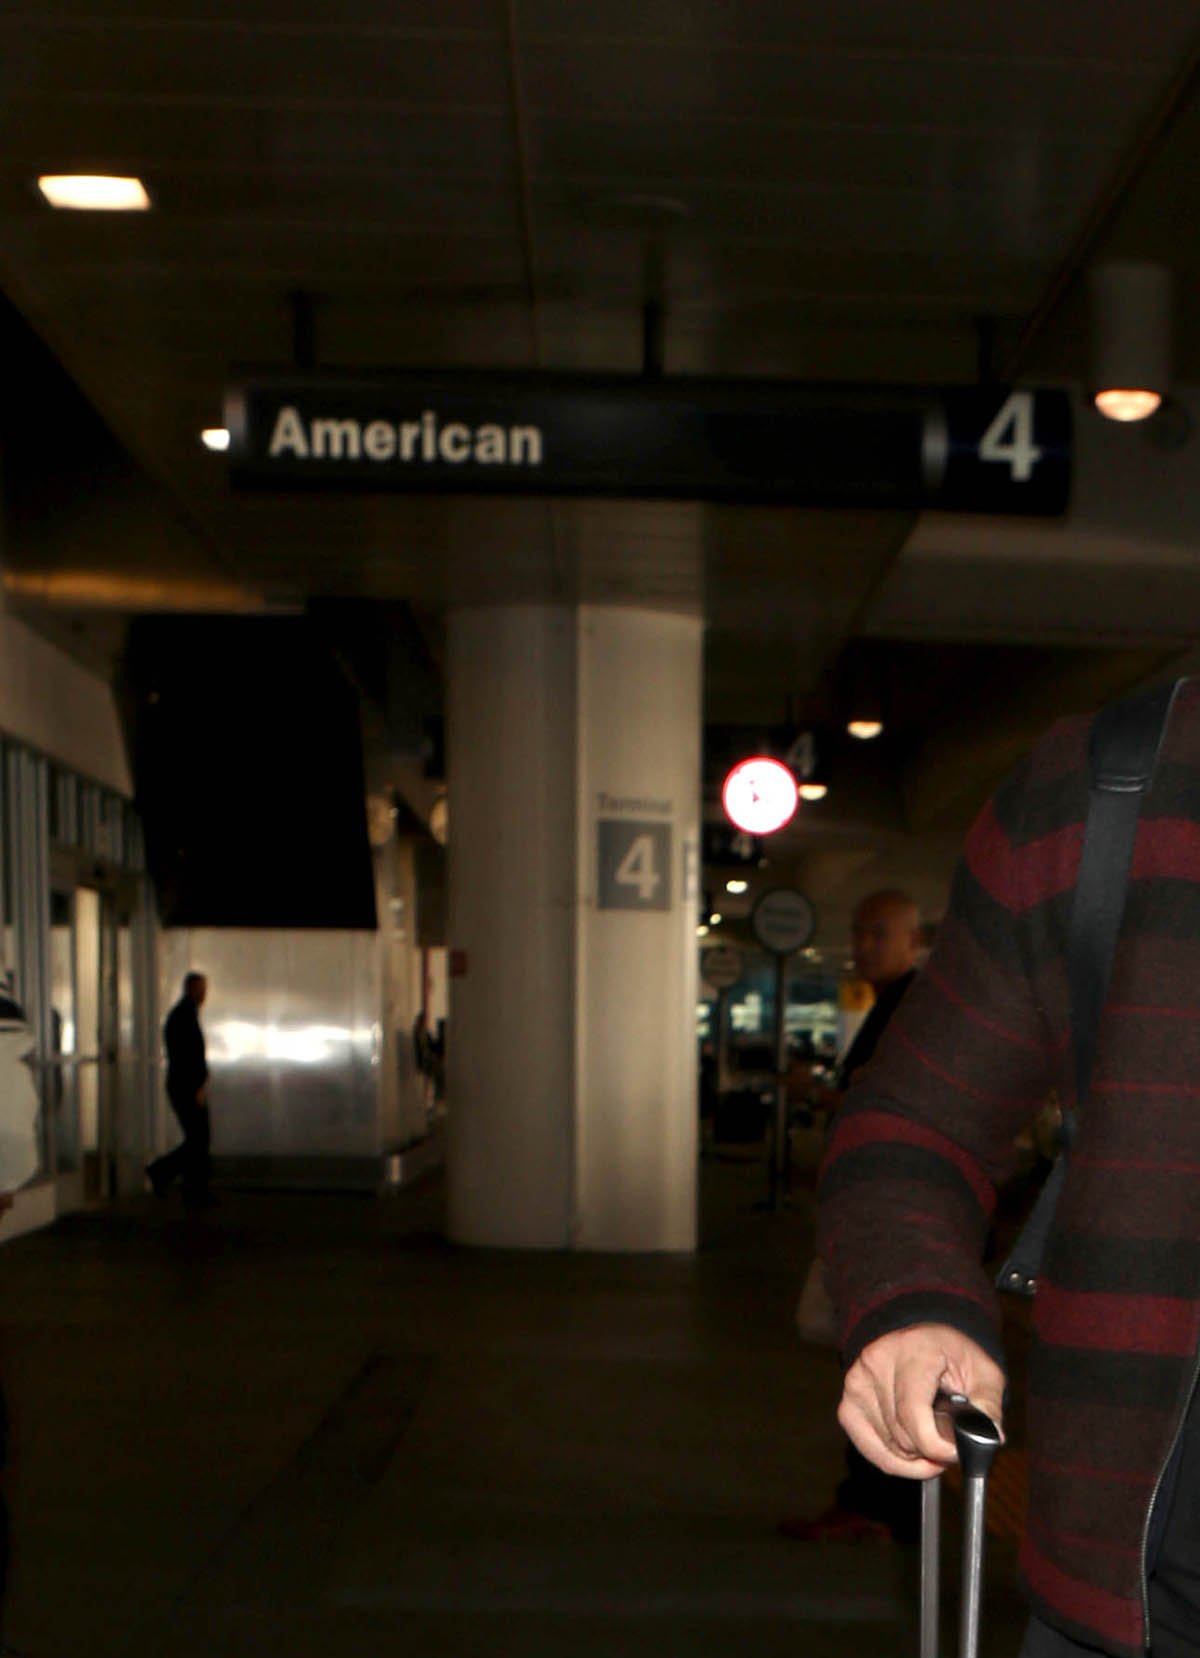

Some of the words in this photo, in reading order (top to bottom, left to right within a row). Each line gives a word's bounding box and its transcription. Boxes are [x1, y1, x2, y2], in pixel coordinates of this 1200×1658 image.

[268, 404, 543, 467] American
[977, 390, 1043, 483] 4
[614, 833, 661, 899] 4
